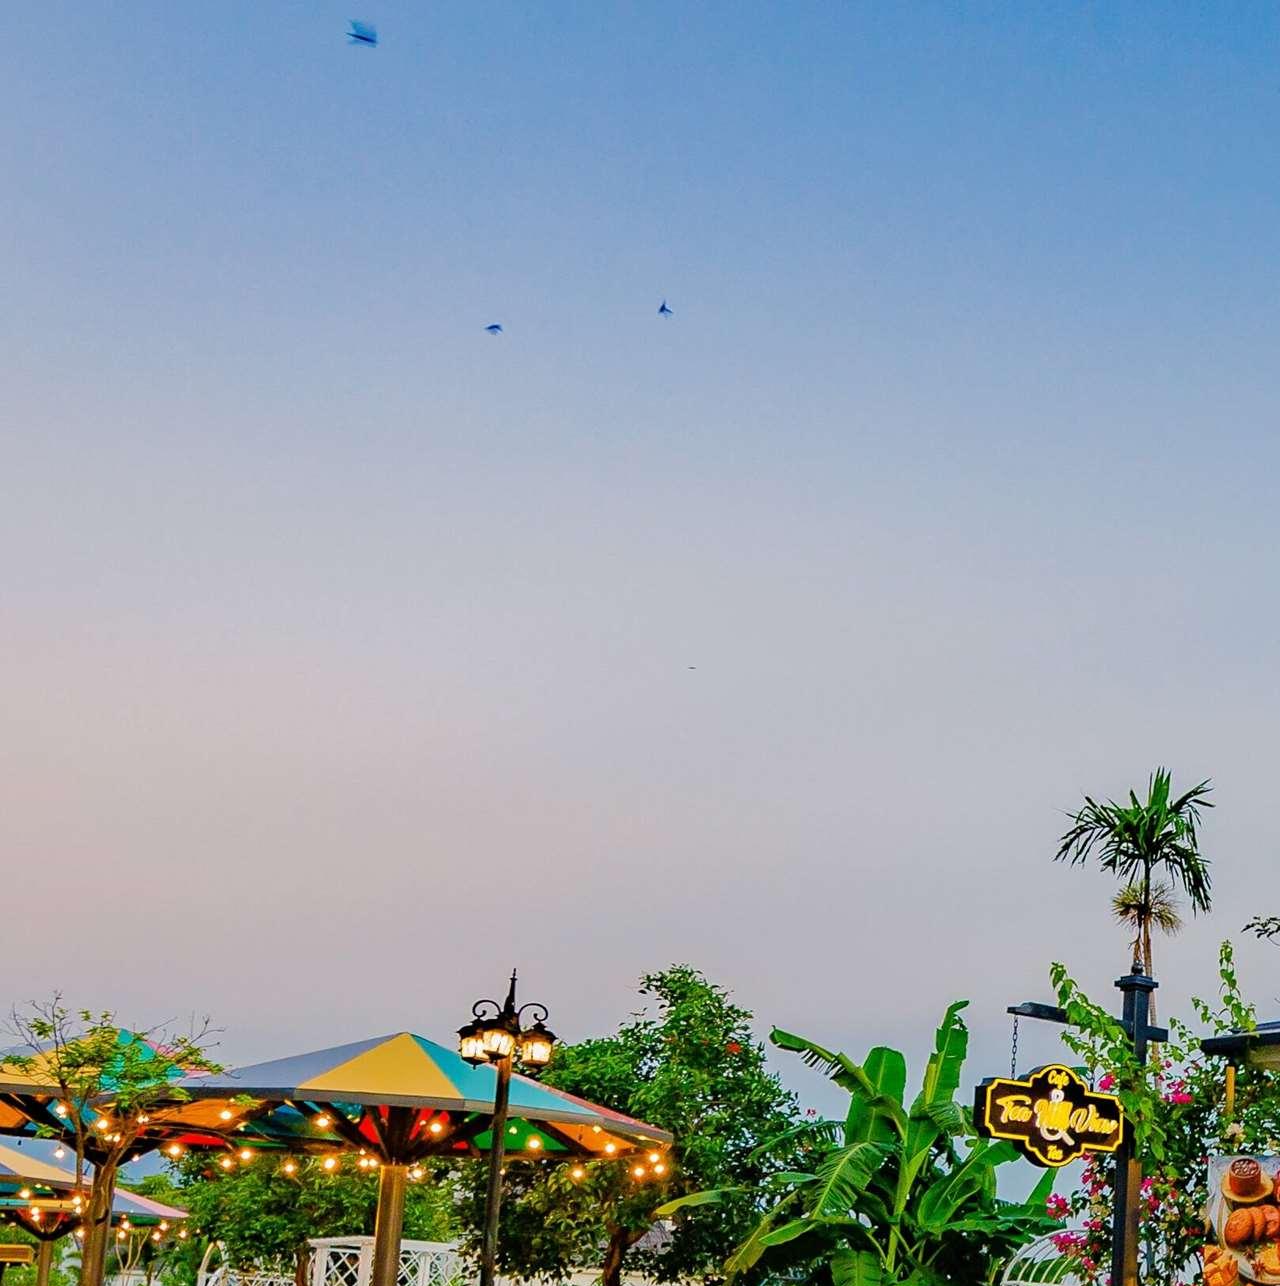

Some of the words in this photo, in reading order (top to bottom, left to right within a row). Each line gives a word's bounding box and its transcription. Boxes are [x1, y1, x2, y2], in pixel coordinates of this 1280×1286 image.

[996, 1095, 1033, 1124] Tea
[1034, 1099, 1073, 1131] Hill
[1070, 1104, 1118, 1134] View
